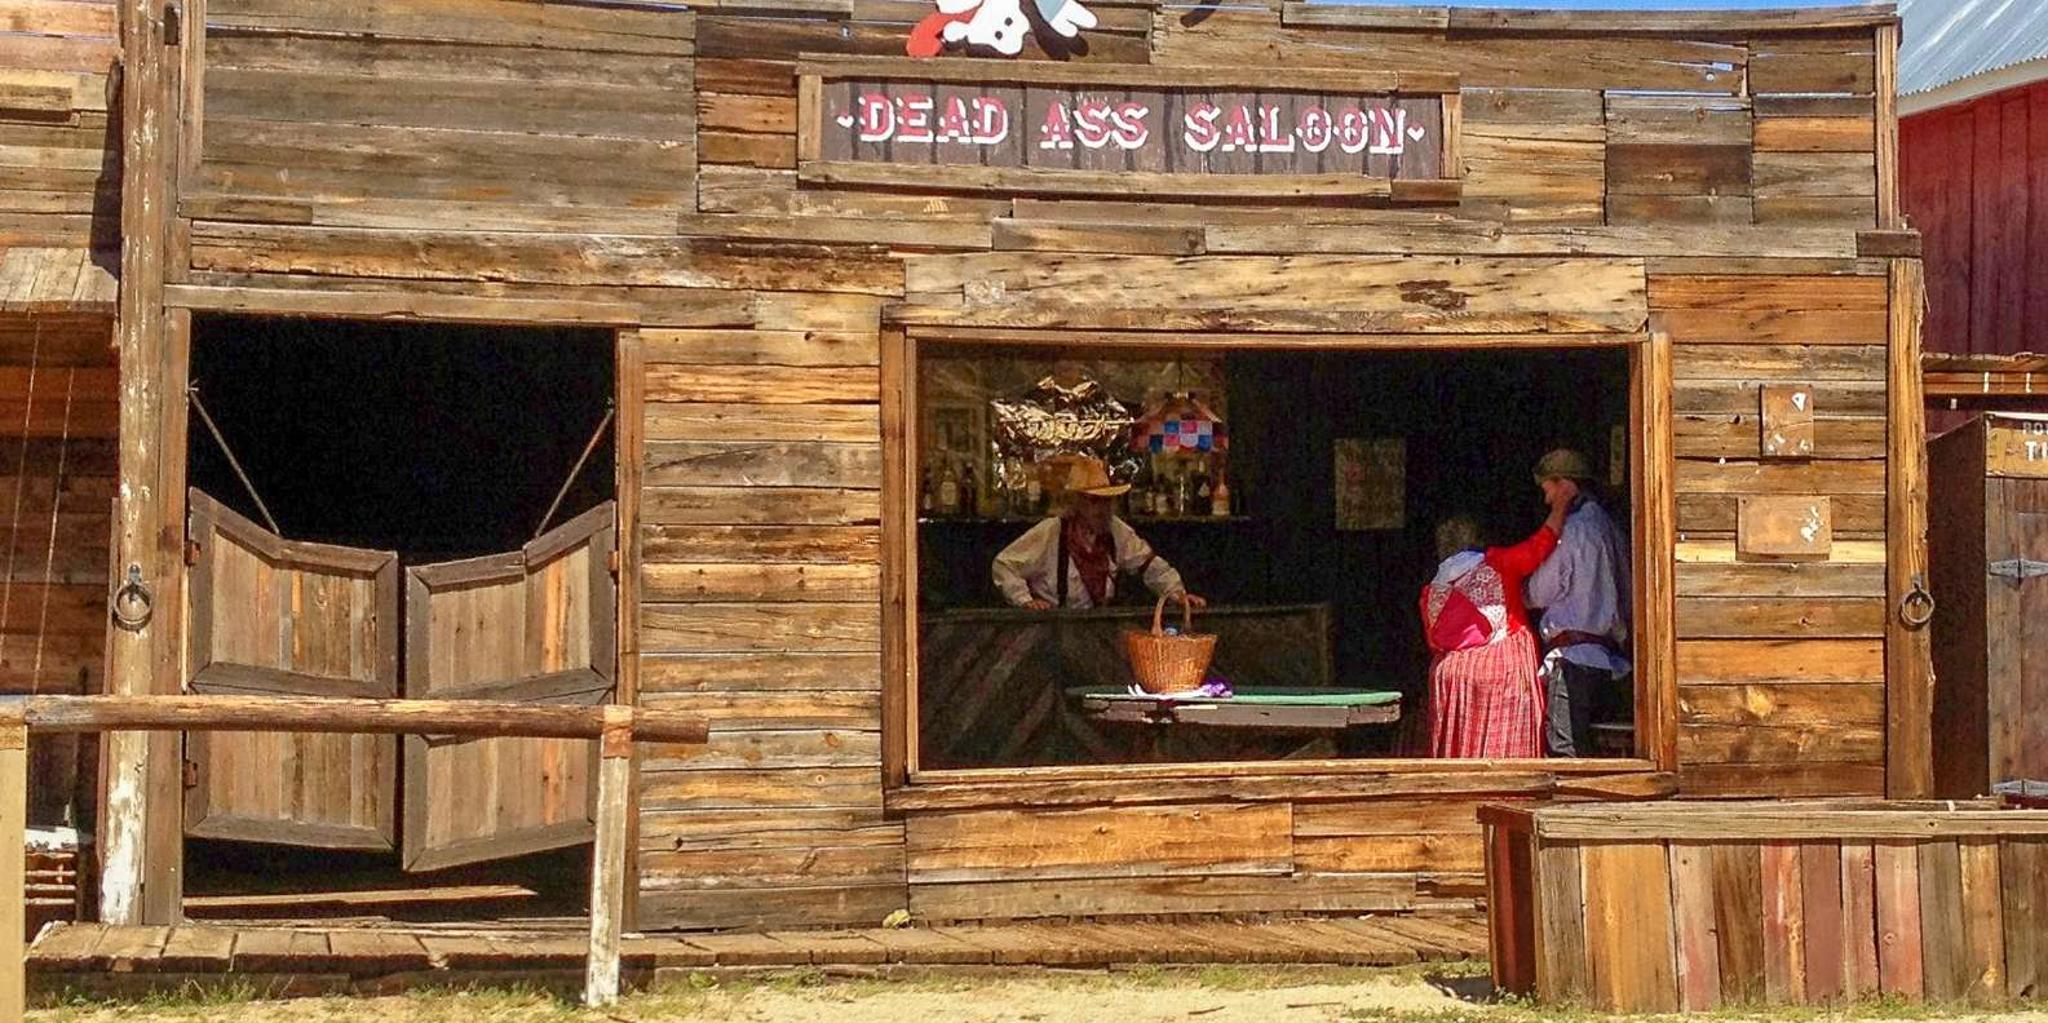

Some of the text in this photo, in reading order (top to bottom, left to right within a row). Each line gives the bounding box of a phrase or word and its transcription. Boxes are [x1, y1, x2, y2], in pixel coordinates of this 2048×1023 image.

[858, 94, 1406, 154] DEAD ASS SALOON
